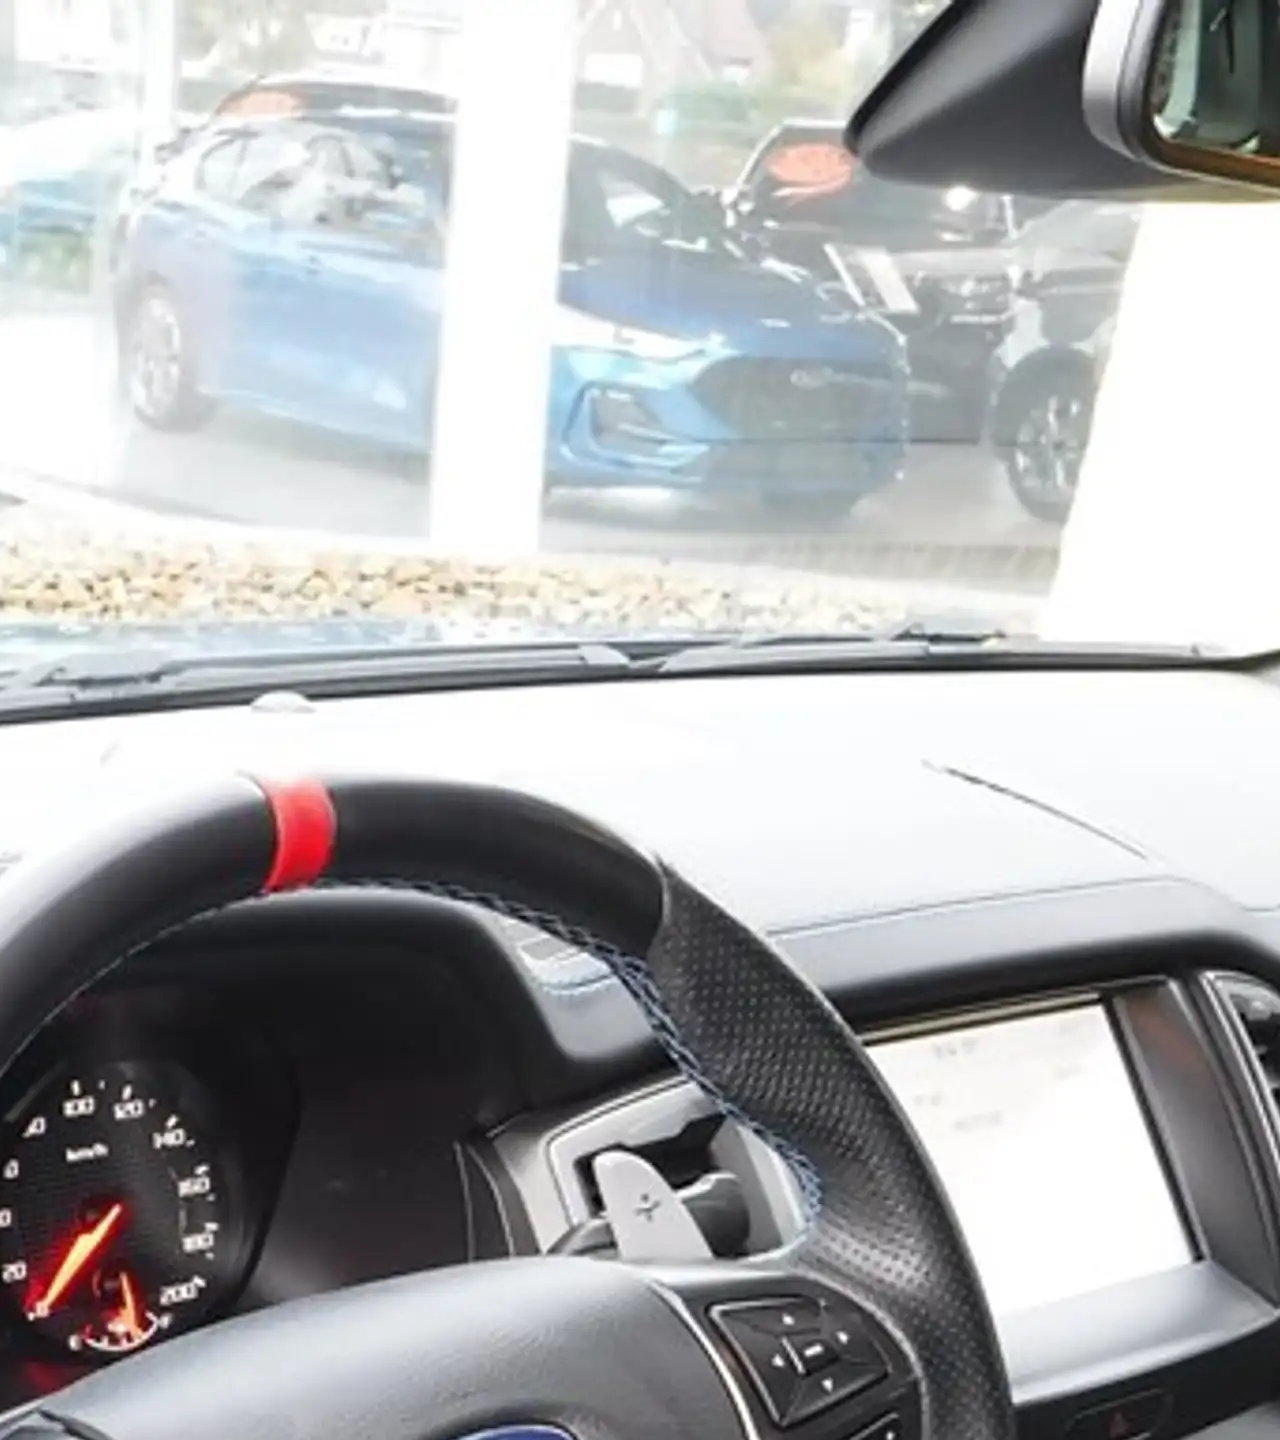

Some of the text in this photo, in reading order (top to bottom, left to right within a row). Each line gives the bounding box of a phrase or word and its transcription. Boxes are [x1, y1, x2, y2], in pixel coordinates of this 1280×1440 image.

[63, 1096, 95, 1117] 100
[114, 1099, 144, 1120] 120
[153, 1130, 186, 1149] 140
[2, 1261, 27, 1283] 20
[160, 1282, 198, 1305] 200
